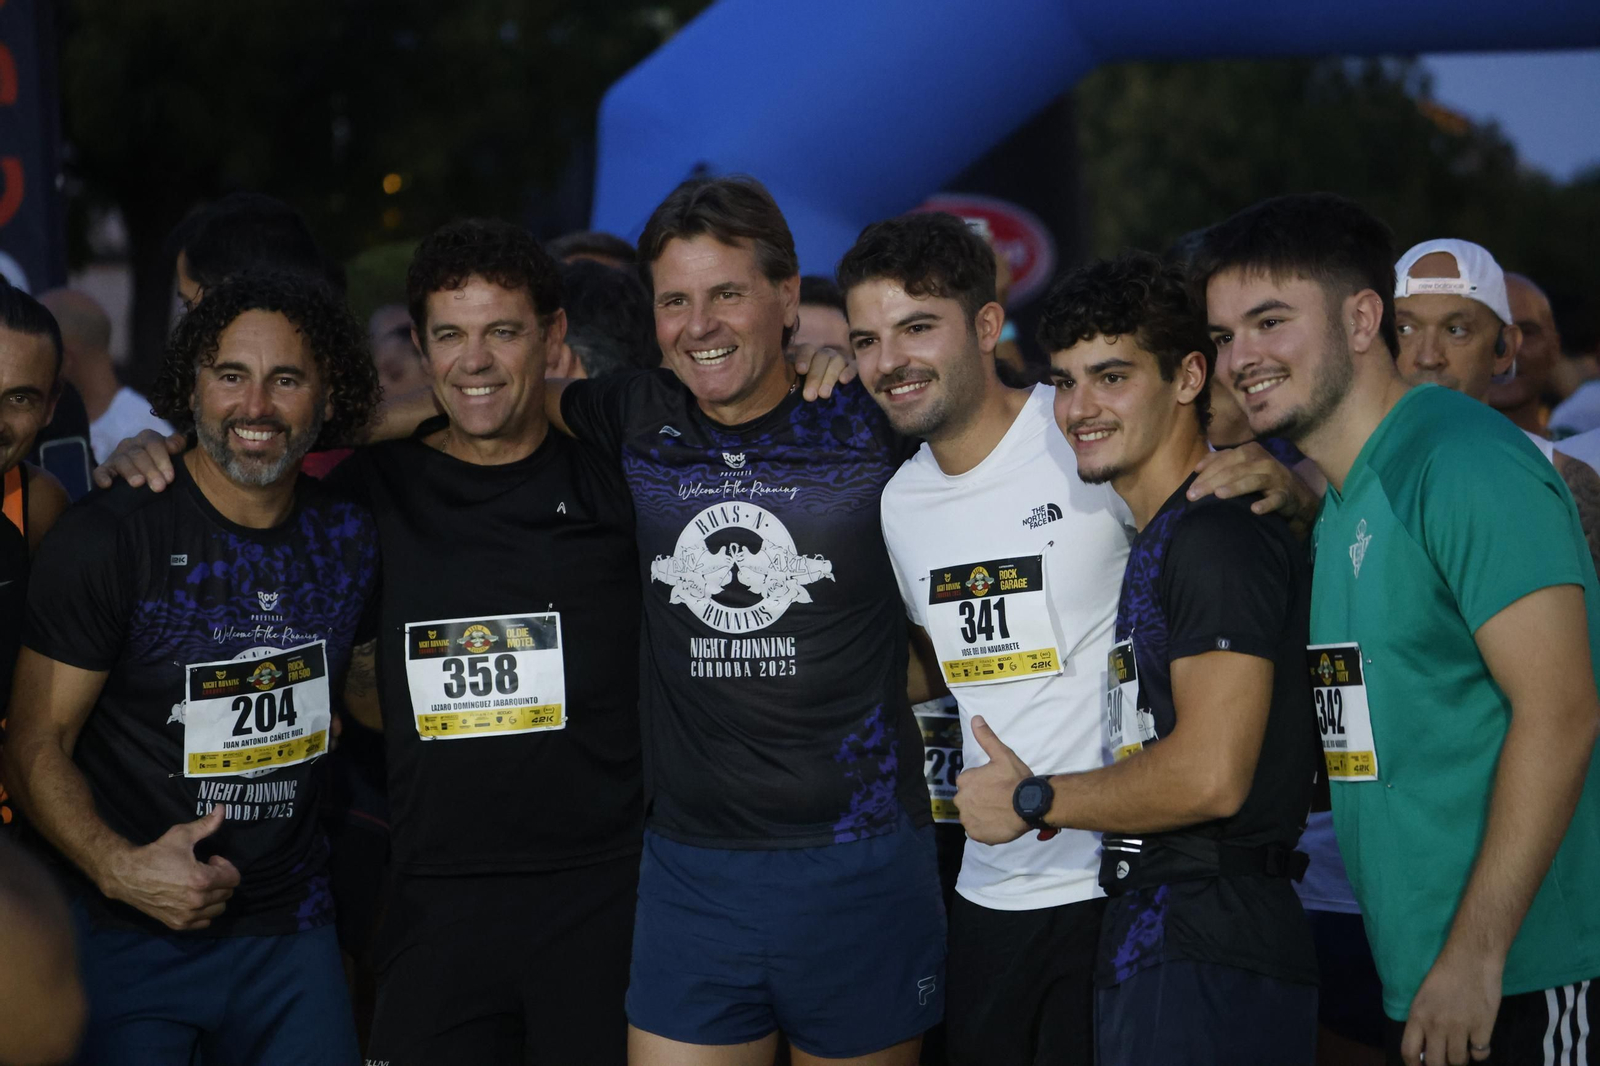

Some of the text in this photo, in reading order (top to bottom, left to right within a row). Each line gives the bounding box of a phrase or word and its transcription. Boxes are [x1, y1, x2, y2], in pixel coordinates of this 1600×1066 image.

[722, 452, 746, 463] Rock
[678, 480, 800, 501] Welcome to the Running
[1031, 504, 1045, 514] THE
[1022, 510, 1047, 526] NORTH
[1029, 518, 1047, 530] FACE
[999, 568, 1017, 580] ROCK
[1000, 578, 1028, 591] GARAGE
[257, 591, 279, 602] Rock
[703, 606, 773, 630] RUNNERS
[958, 597, 1010, 644] 341
[213, 624, 320, 646] Welcome to the Running
[505, 627, 529, 638] OLDIE
[506, 637, 535, 649] MOTEL
[690, 637, 796, 659] NIGHT RUNNING
[987, 642, 1020, 653] NAVARRETE
[287, 660, 304, 672] ROCK
[690, 659, 797, 678] CÓRDOBA 2025
[1031, 661, 1052, 670] 42K
[288, 668, 311, 682] FM 500
[442, 653, 519, 699] 358
[202, 678, 240, 690] NIGHT RUNNING
[231, 687, 297, 737] 204
[431, 696, 539, 712] LAZARO DOMÍNGUEZ JABARQUINTO
[1107, 687, 1123, 737] 340
[1315, 688, 1345, 735] 342
[531, 715, 554, 724] 42K
[223, 728, 304, 749] JUAN ANTONIO CAÑETE RUIZ
[197, 780, 298, 803] NIGHT RUNNING
[196, 800, 294, 821] CÓDOBA 2025
